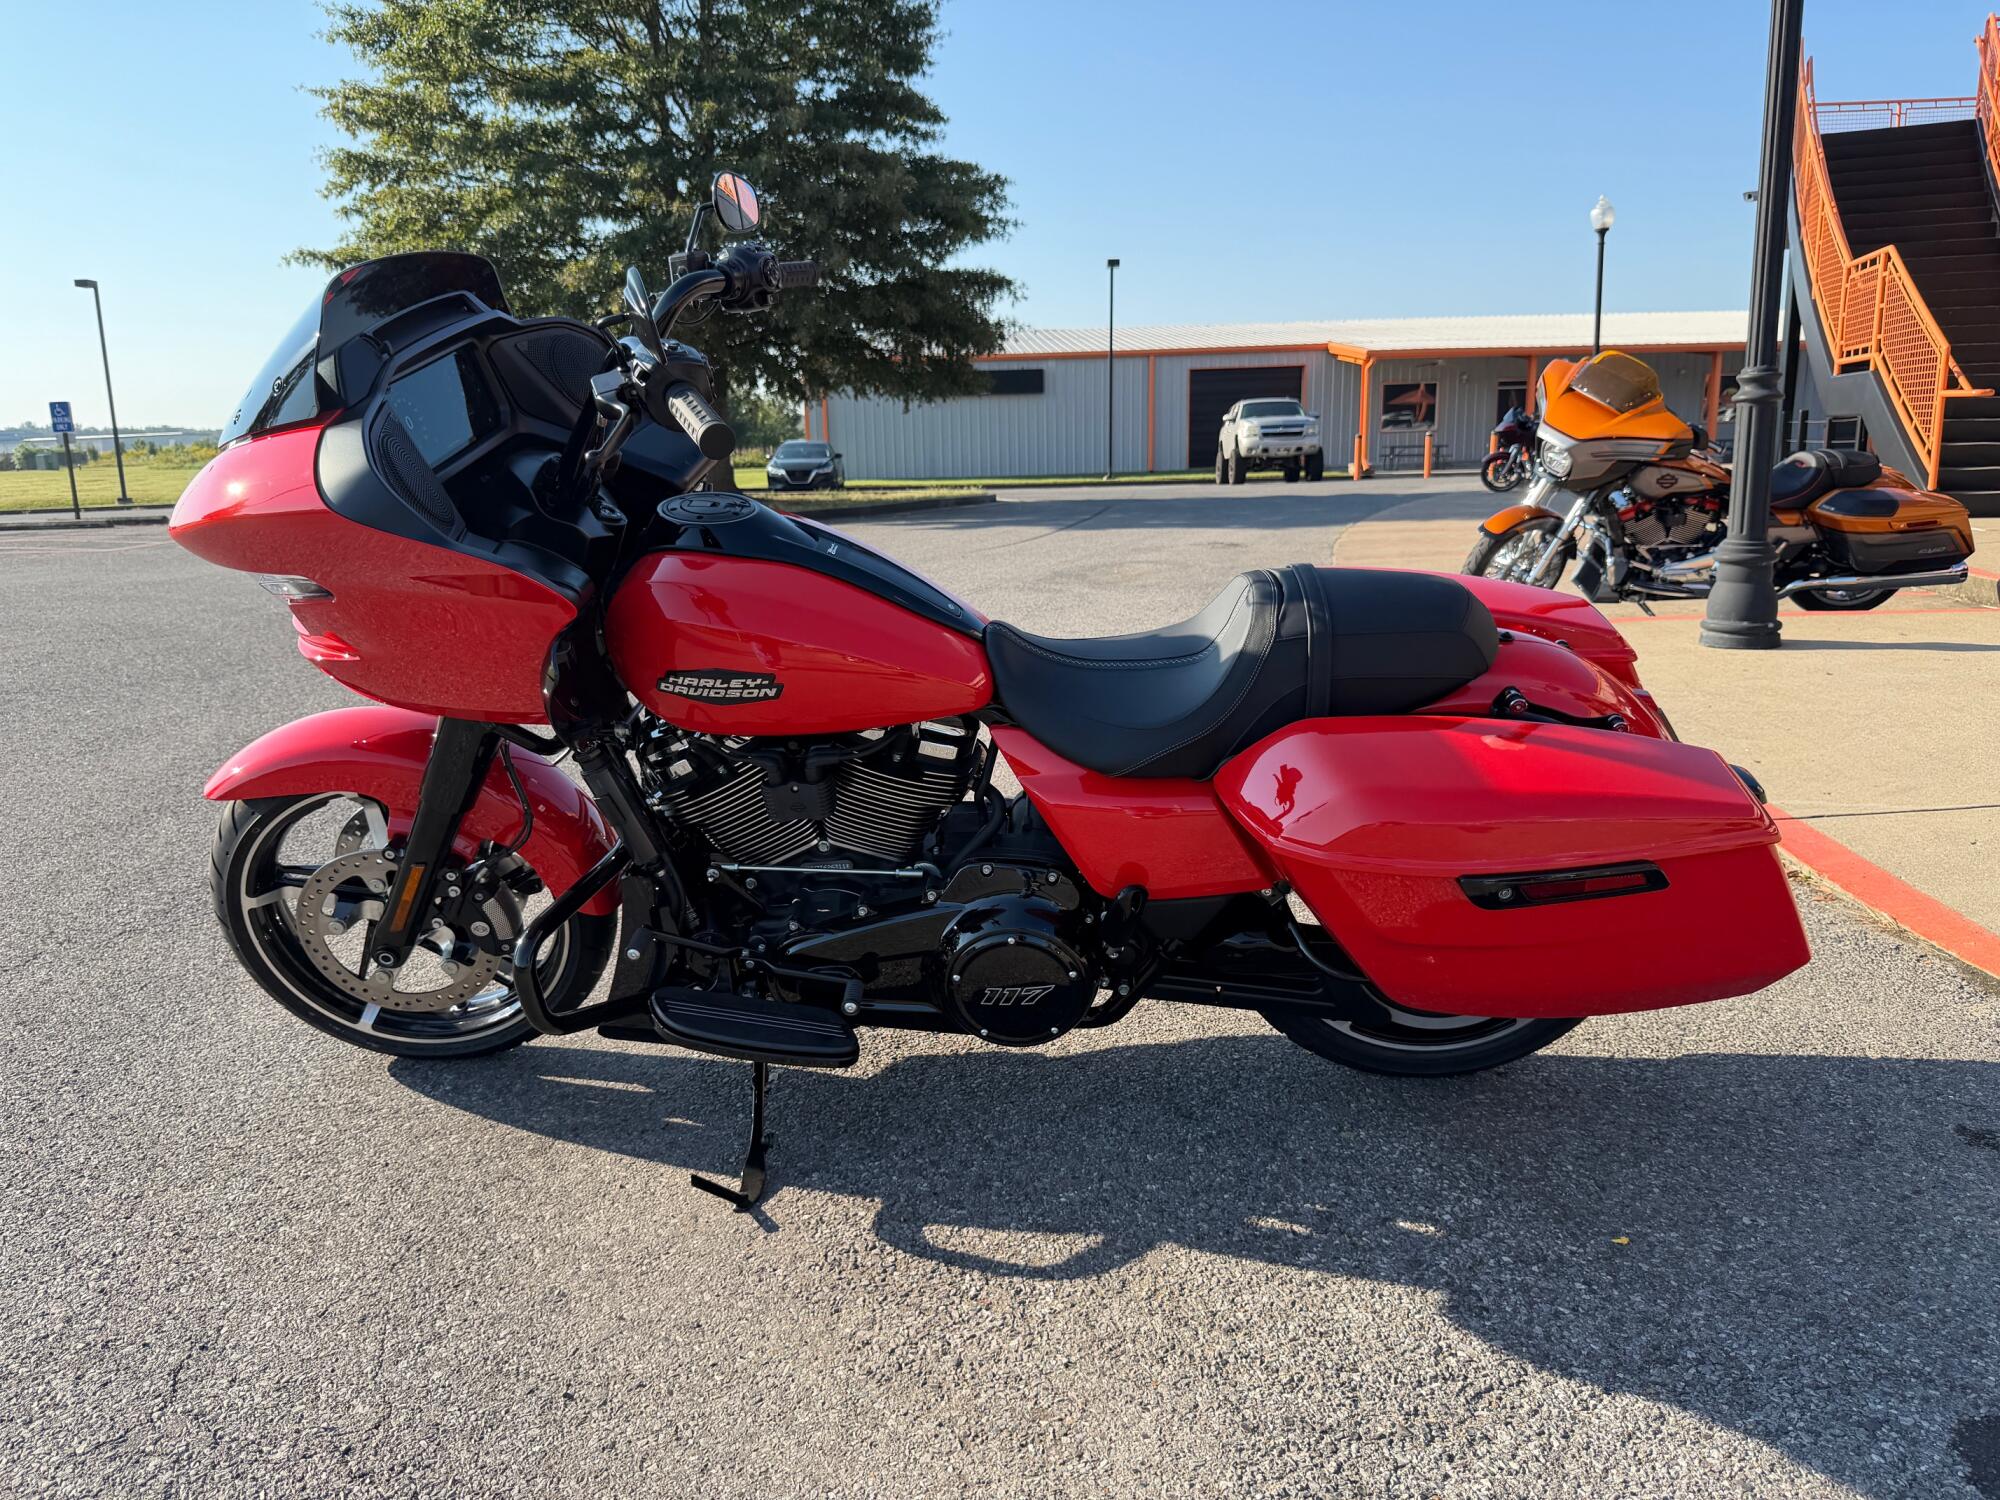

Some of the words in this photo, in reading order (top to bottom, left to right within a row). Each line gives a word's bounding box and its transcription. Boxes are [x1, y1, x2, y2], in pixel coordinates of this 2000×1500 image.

[660, 682, 778, 698] DAVIDSON
[668, 676, 769, 688] HARLEY-
[980, 984, 1056, 1006] 117
